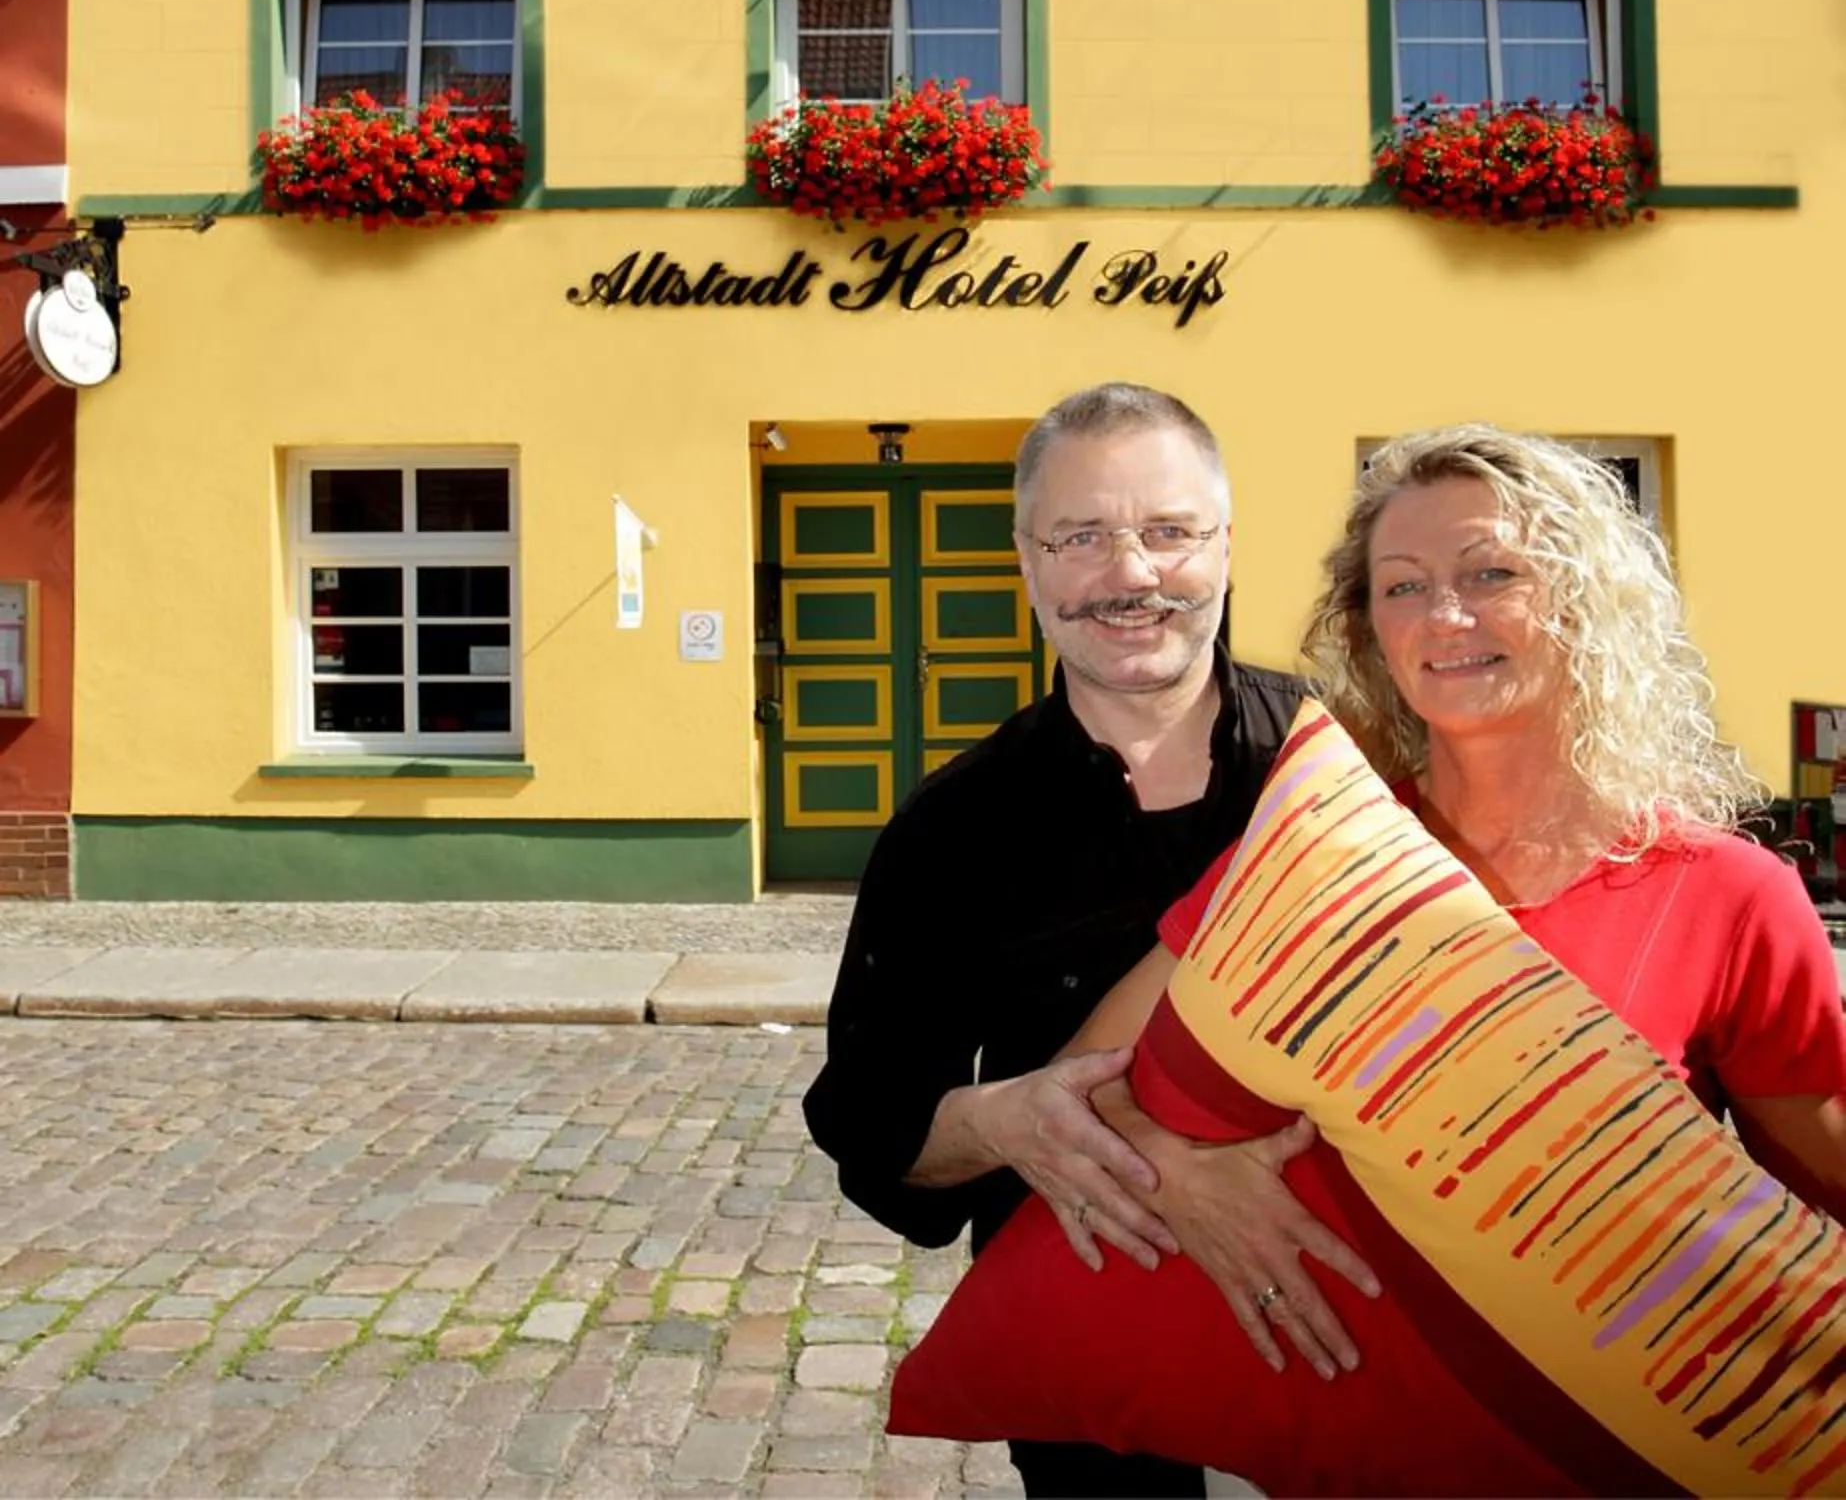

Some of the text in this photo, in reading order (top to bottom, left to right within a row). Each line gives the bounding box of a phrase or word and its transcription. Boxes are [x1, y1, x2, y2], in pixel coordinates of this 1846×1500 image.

[566, 228, 1228, 329] Altstadt Hotel Peiß
